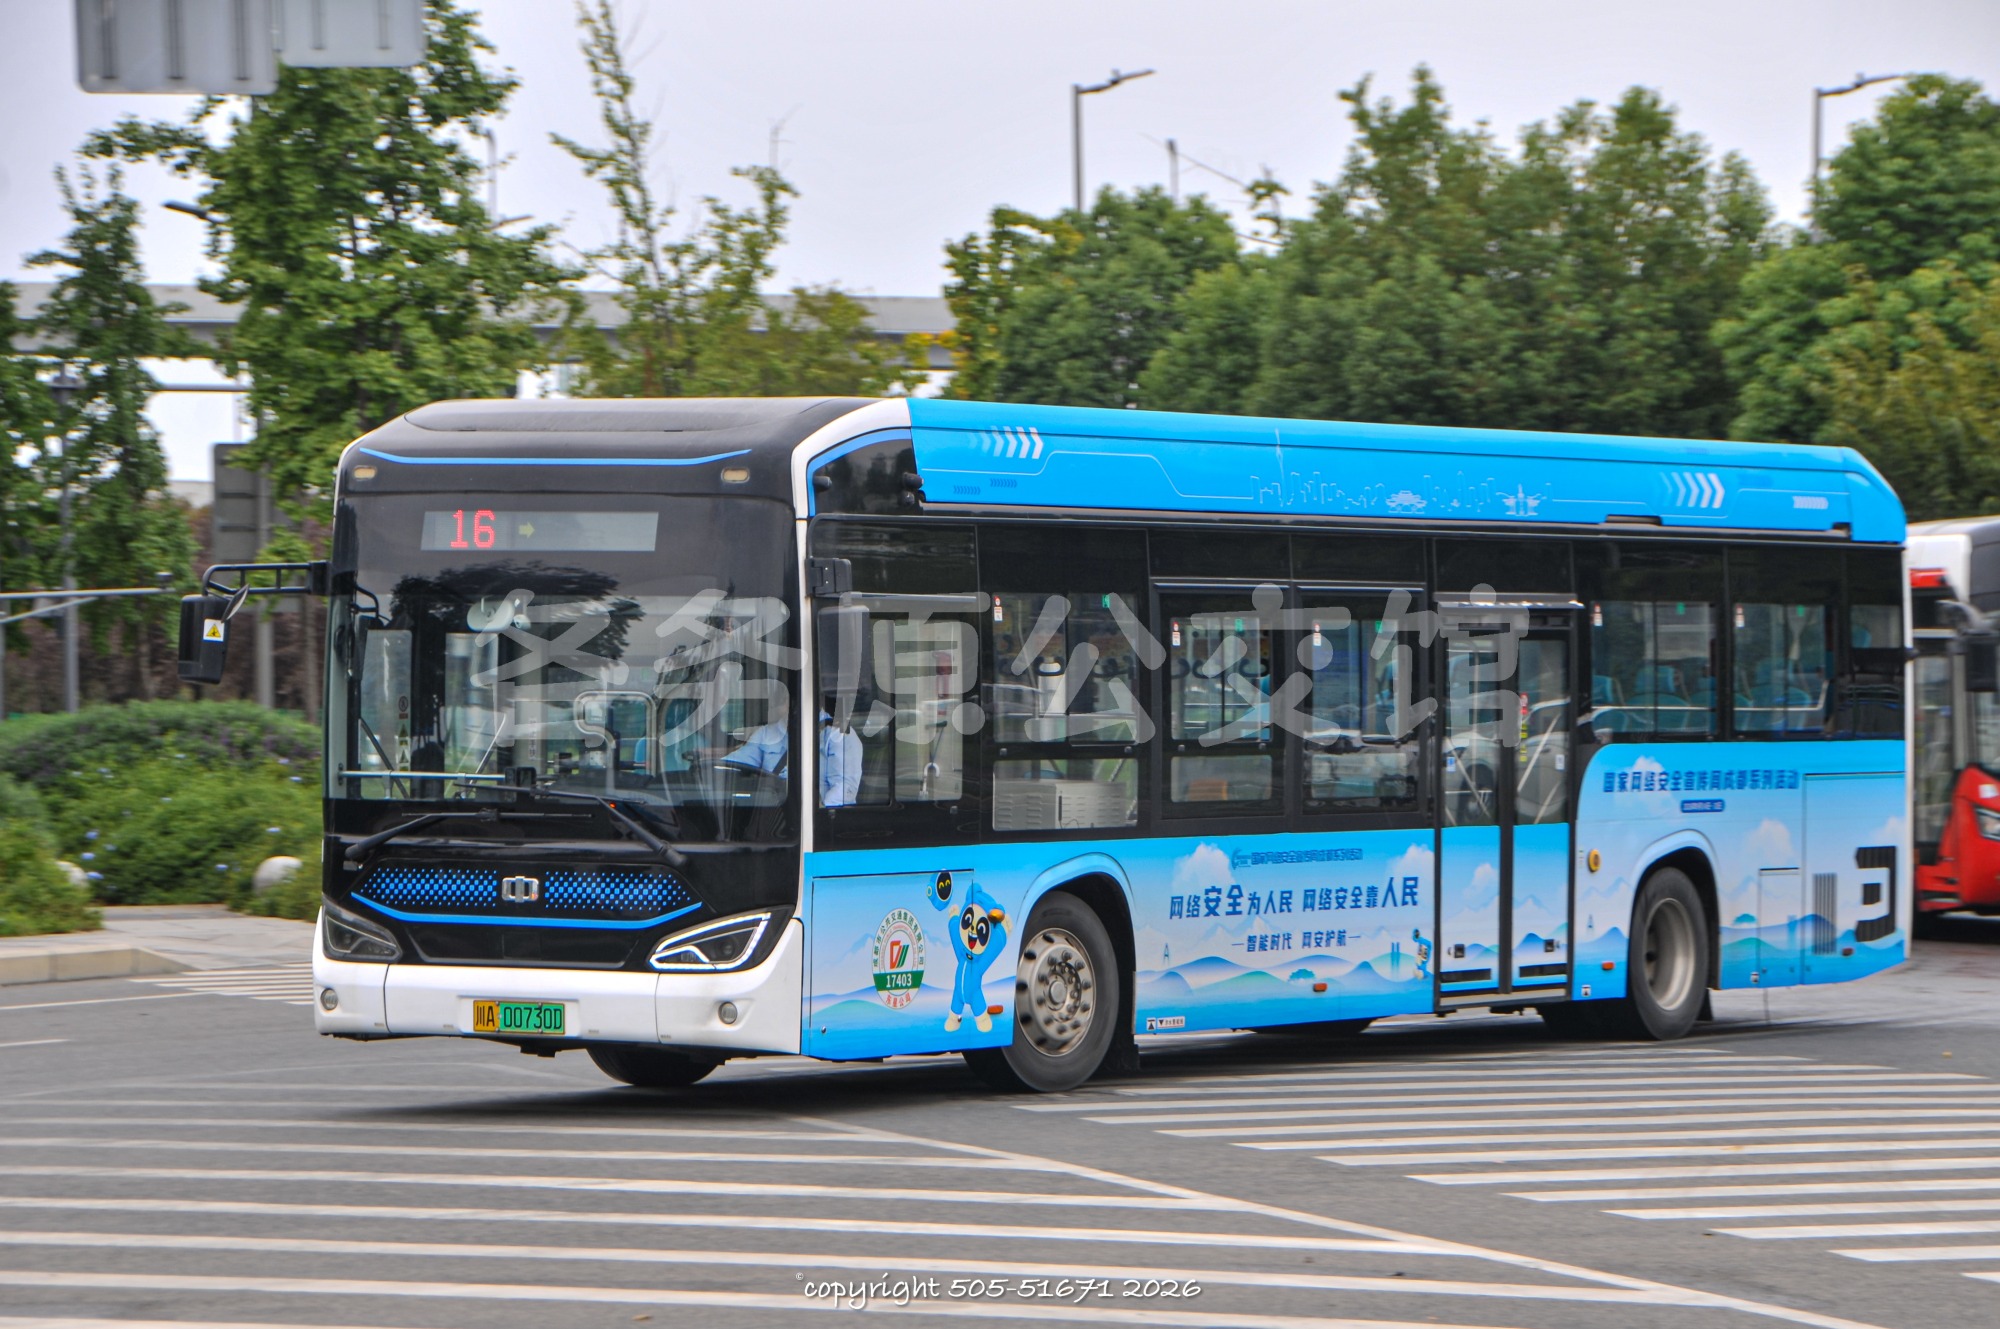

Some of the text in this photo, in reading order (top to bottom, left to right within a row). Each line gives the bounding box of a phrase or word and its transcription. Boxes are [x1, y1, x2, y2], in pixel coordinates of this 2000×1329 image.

[450, 509, 496, 548] 16
[1170, 876, 1419, 919] 网络安全为人民 网络安全靠人民
[1246, 929, 1347, 952] 智能时代 网安护航
[886, 973, 912, 988] 17403
